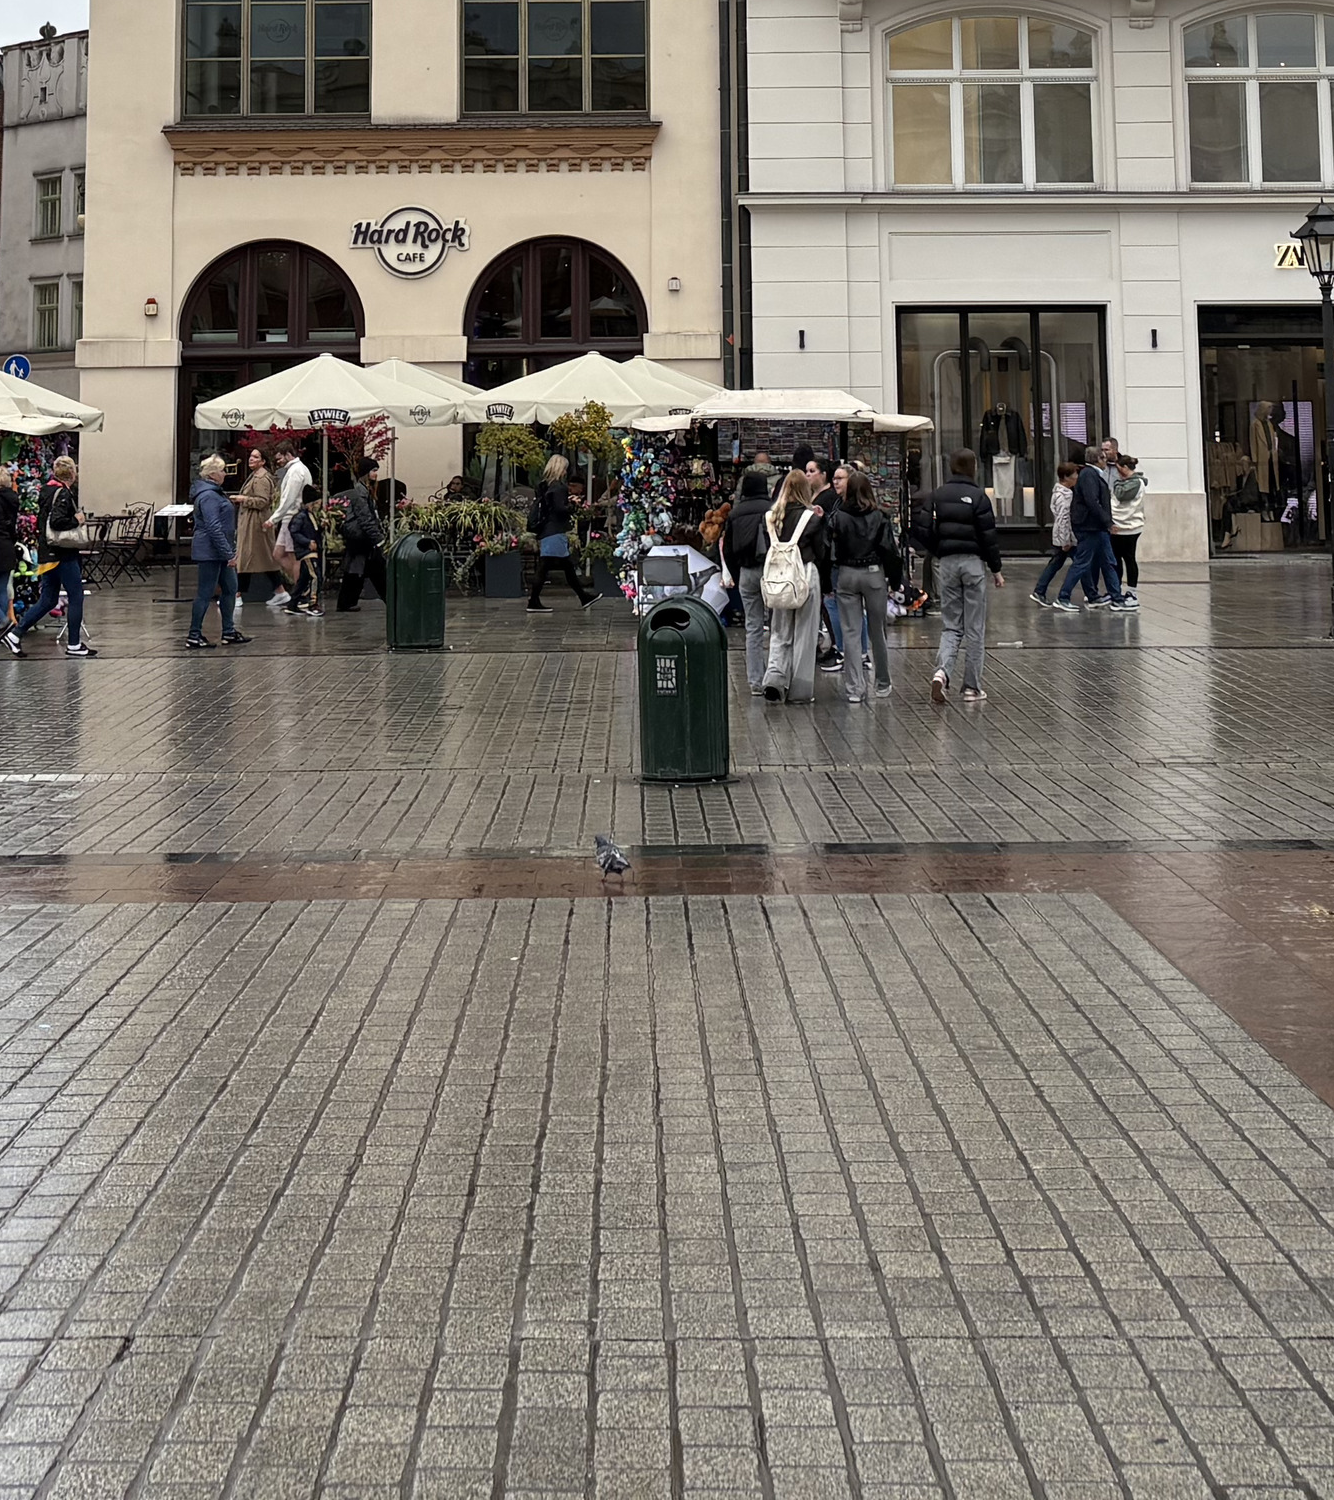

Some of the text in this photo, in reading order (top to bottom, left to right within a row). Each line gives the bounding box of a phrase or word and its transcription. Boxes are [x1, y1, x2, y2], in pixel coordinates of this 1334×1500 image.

[352, 220, 466, 249] Hard Rock
[396, 252, 425, 262] CAFE
